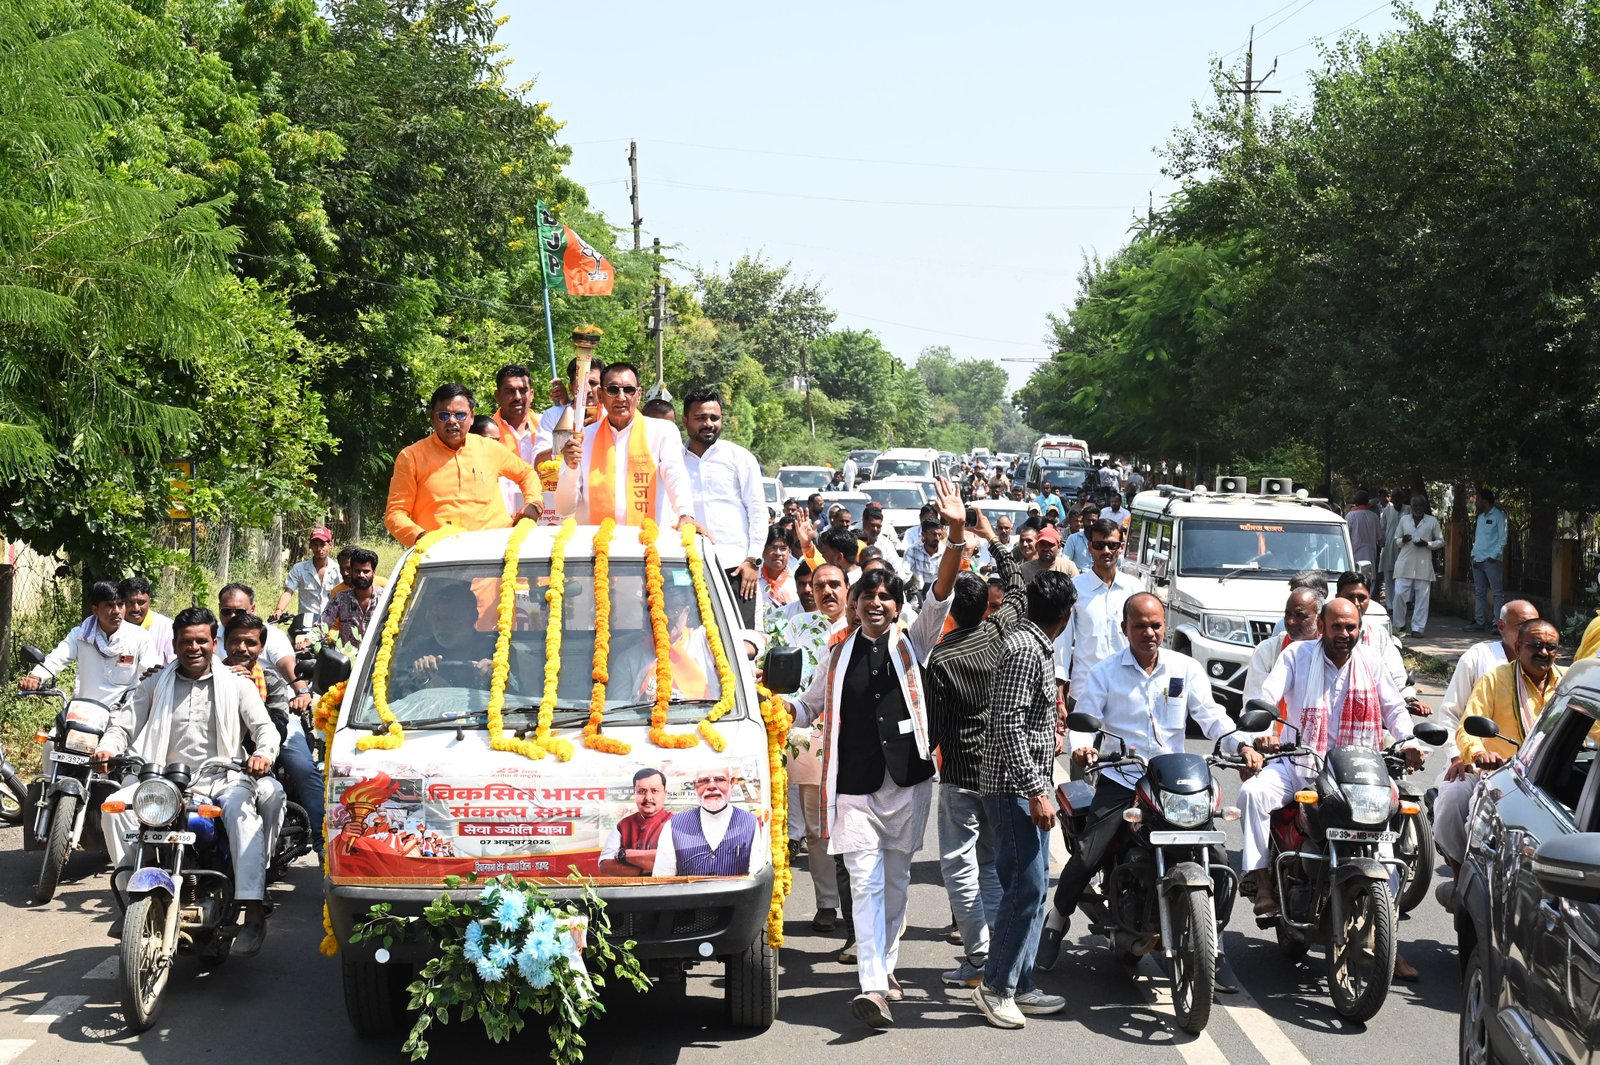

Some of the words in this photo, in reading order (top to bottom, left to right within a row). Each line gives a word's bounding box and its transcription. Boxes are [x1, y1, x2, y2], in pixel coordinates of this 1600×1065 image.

[633, 472, 650, 513] भाजपा
[427, 783, 535, 802] विकसित
[541, 787, 607, 800] भारत
[449, 803, 528, 818] संकल्प
[533, 806, 582, 818] सभा
[463, 824, 491, 835] सेवा
[495, 824, 533, 835] ज्योति
[537, 825, 567, 835] यात्रा
[493, 839, 526, 847] अक्टूबर
